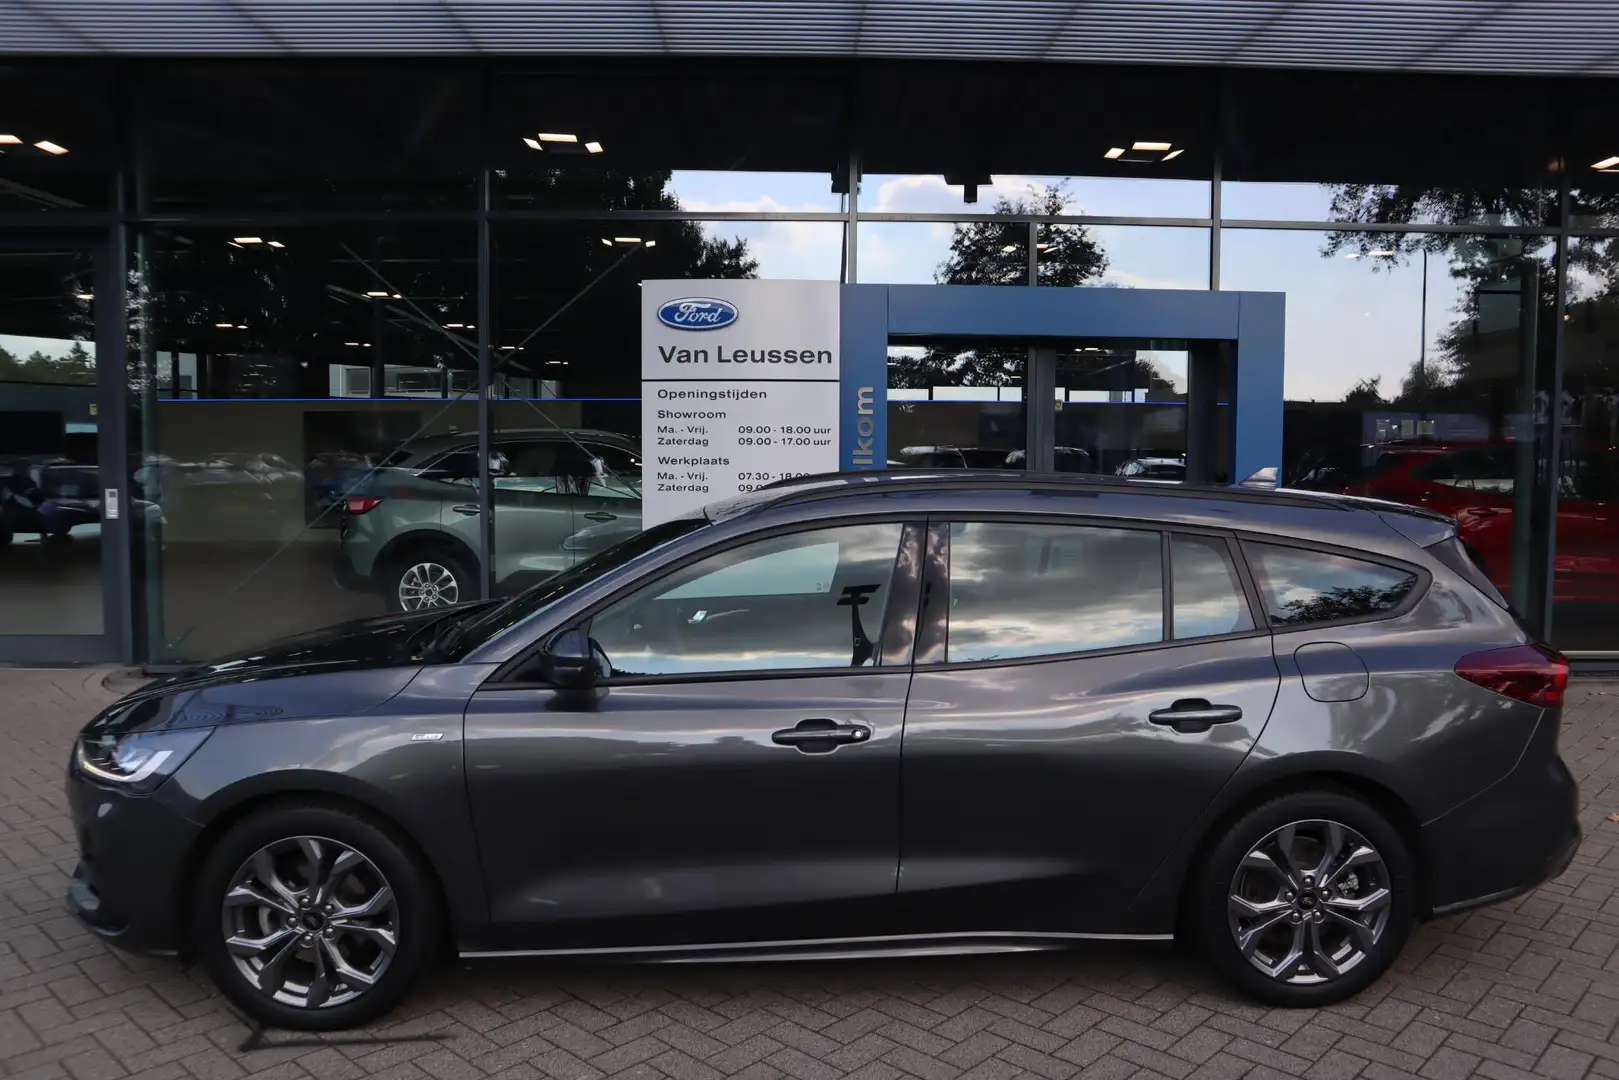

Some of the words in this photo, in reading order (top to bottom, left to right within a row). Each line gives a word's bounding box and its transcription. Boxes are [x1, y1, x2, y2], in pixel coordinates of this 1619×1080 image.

[674, 302, 723, 323] Ford
[658, 345, 709, 364] Van
[717, 345, 832, 364] Leussen
[657, 389, 768, 401] Openingstijden
[657, 409, 727, 419] Showroom
[657, 425, 678, 434] Ma.
[686, 425, 709, 435] Vrij.
[738, 425, 771, 434] 09.00
[780, 425, 811, 434] 18.00
[813, 427, 832, 435] uur
[852, 386, 874, 469] lkom
[657, 437, 709, 447] Zaterdag
[738, 437, 771, 446] 09.00
[781, 437, 811, 446] 17.00
[658, 456, 730, 467] Werkplaats
[657, 472, 678, 480] Ma.
[686, 472, 708, 482] Vrij.
[738, 472, 770, 481] 07.30
[657, 484, 709, 493] Zaterdag
